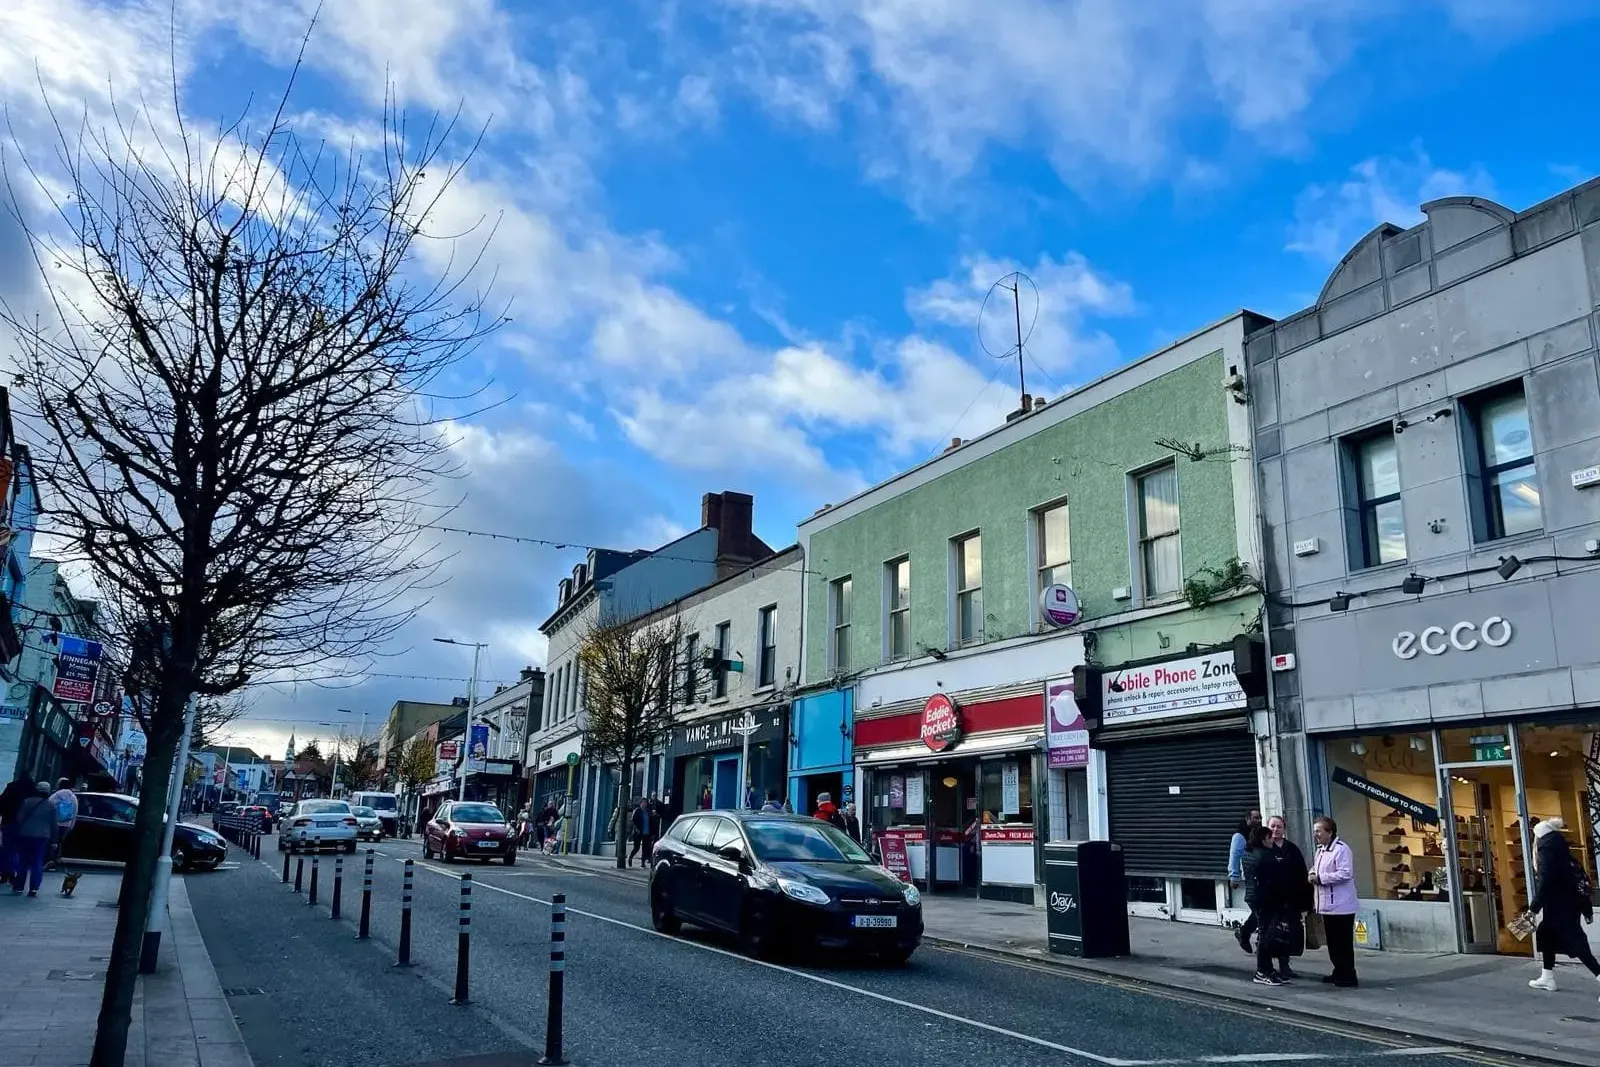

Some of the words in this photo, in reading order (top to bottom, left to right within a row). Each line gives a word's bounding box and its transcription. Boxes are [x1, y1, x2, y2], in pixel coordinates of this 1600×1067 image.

[1392, 616, 1512, 659] ecco
[63, 655, 98, 667] FINNEGAN
[1155, 667, 1197, 686] Phone
[1124, 692, 1141, 702] unlock
[1142, 691, 1148, 699] &
[1201, 680, 1221, 692] laptop
[926, 705, 949, 723] Eddie
[686, 725, 710, 742] VANCE
[722, 715, 756, 736] WILSN
[921, 714, 957, 738] Rocket's
[706, 738, 730, 749] pharmacy
[1347, 777, 1366, 790] BLACK
[1367, 786, 1390, 799] FRIDAY
[1400, 800, 1408, 808] TO
[1409, 804, 1423, 815] 40%
